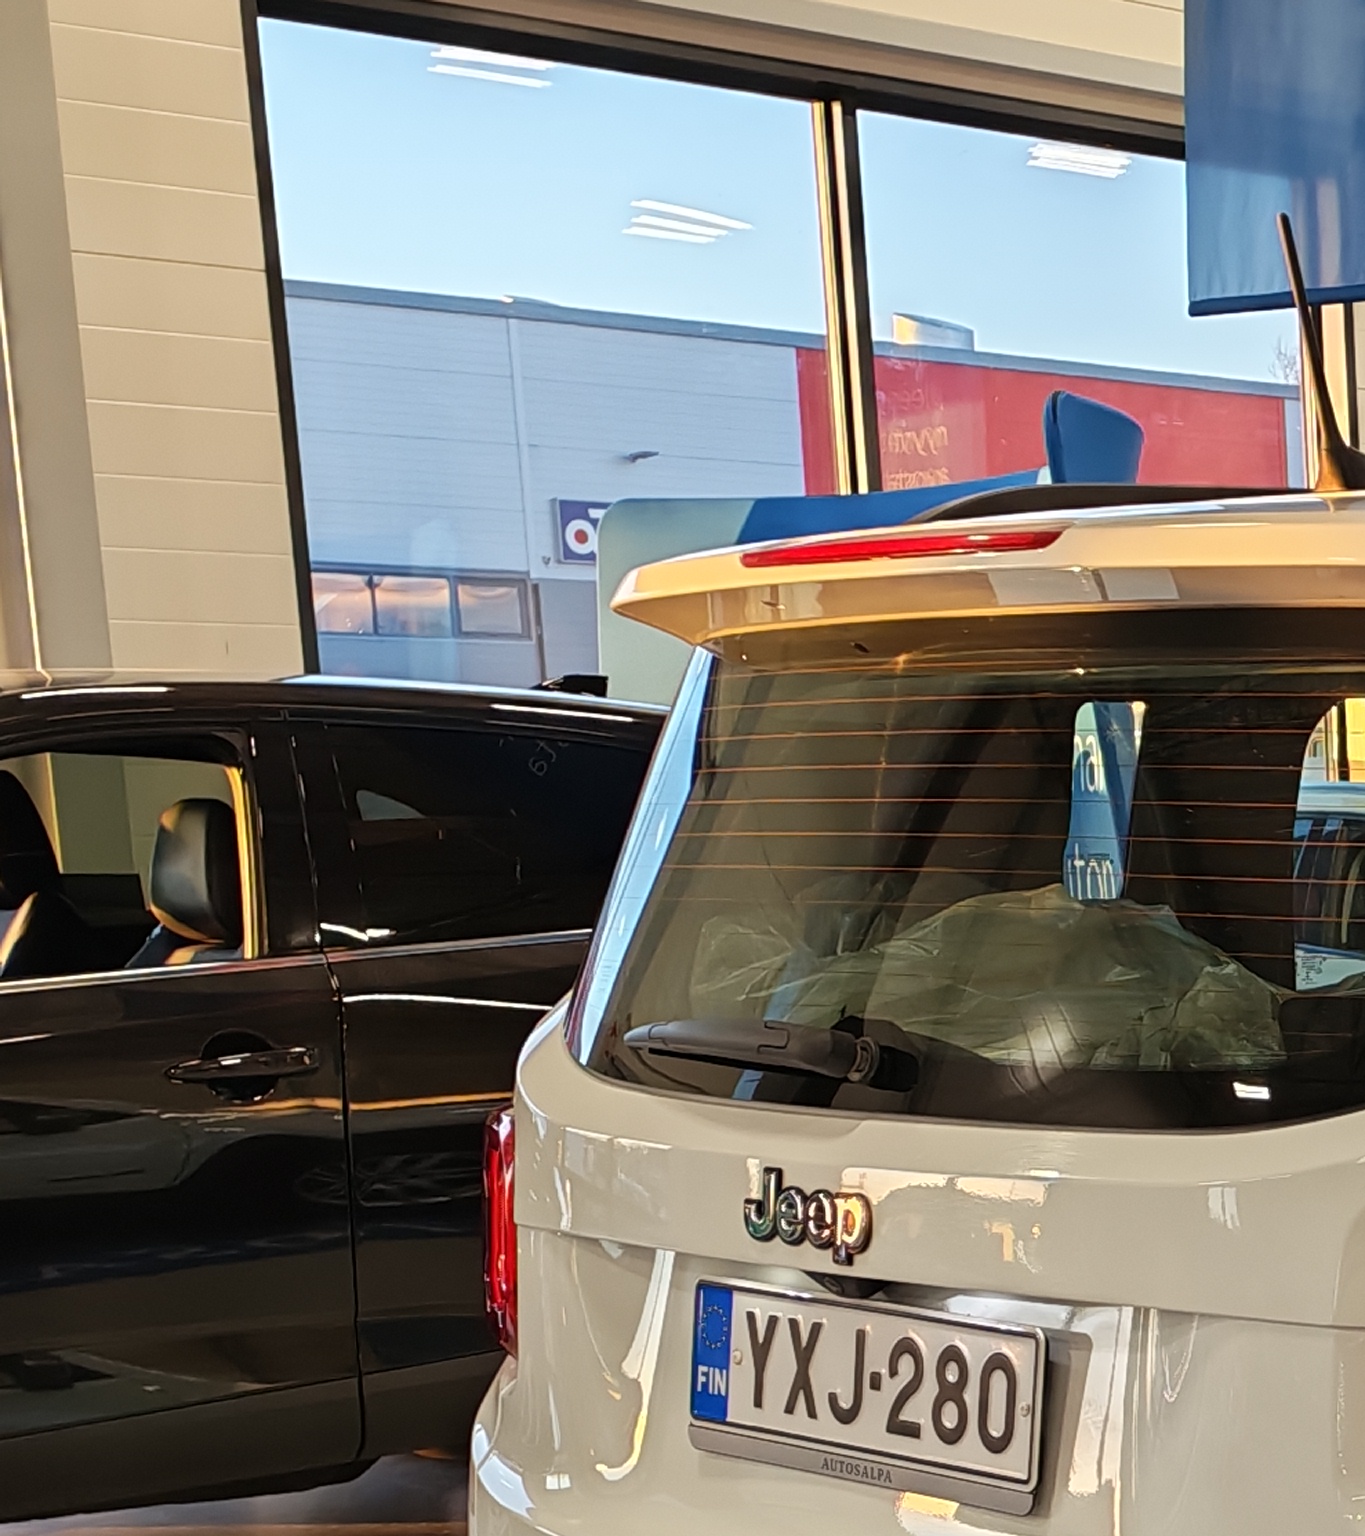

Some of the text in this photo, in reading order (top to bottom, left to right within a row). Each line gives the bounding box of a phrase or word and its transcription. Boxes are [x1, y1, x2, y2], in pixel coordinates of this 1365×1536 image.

[744, 1166, 872, 1266] Jeep
[696, 1364, 727, 1397] FIN
[746, 1310, 1017, 1453] YXJ-280
[820, 1456, 893, 1483] AUTOSALPA
